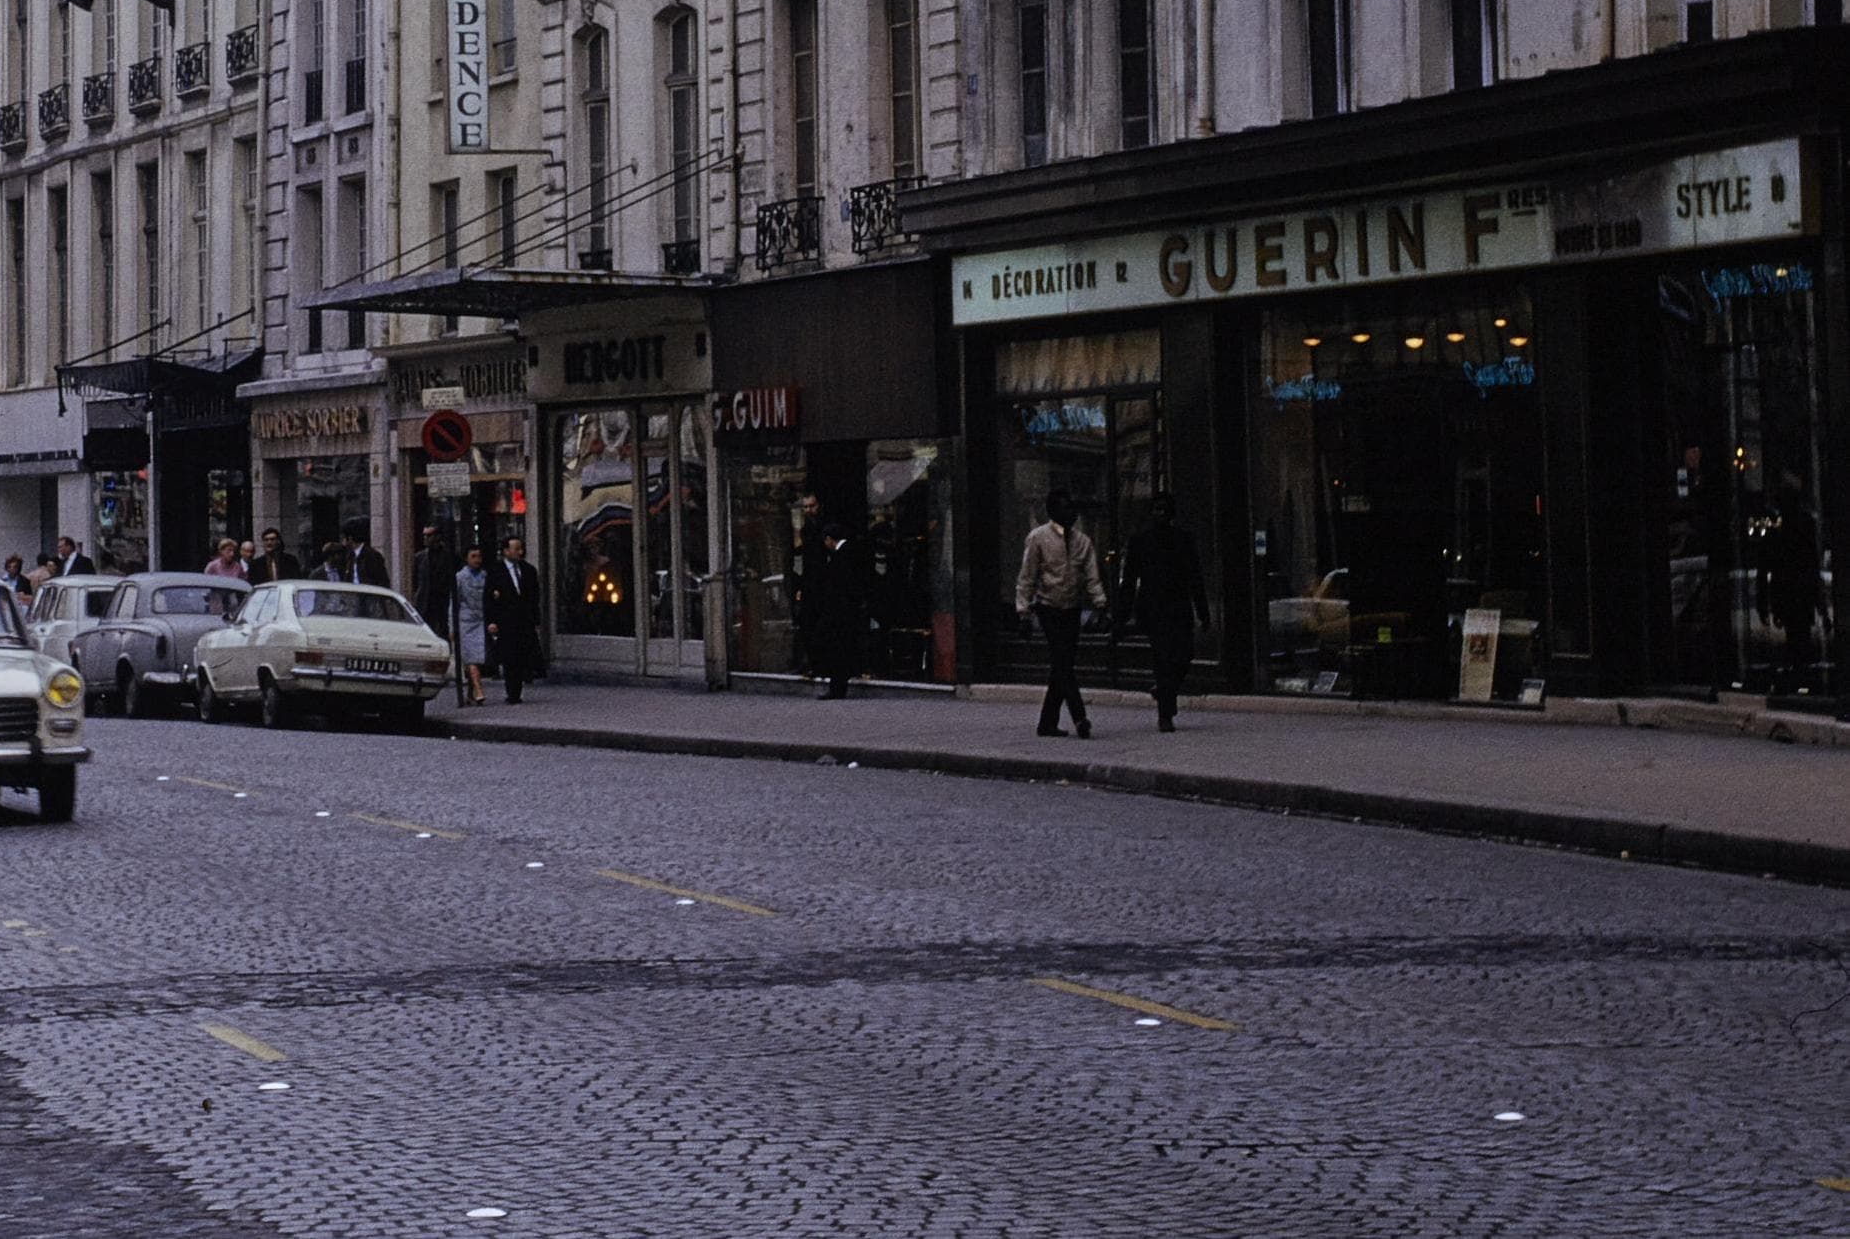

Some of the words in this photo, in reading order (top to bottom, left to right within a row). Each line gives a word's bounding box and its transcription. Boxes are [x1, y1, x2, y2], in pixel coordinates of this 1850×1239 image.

[991, 261, 1097, 300] DÉCORATION
[1158, 201, 1427, 298] GUERIN
[1676, 175, 1752, 219] STYLE
[564, 335, 666, 385] HERGOTT
